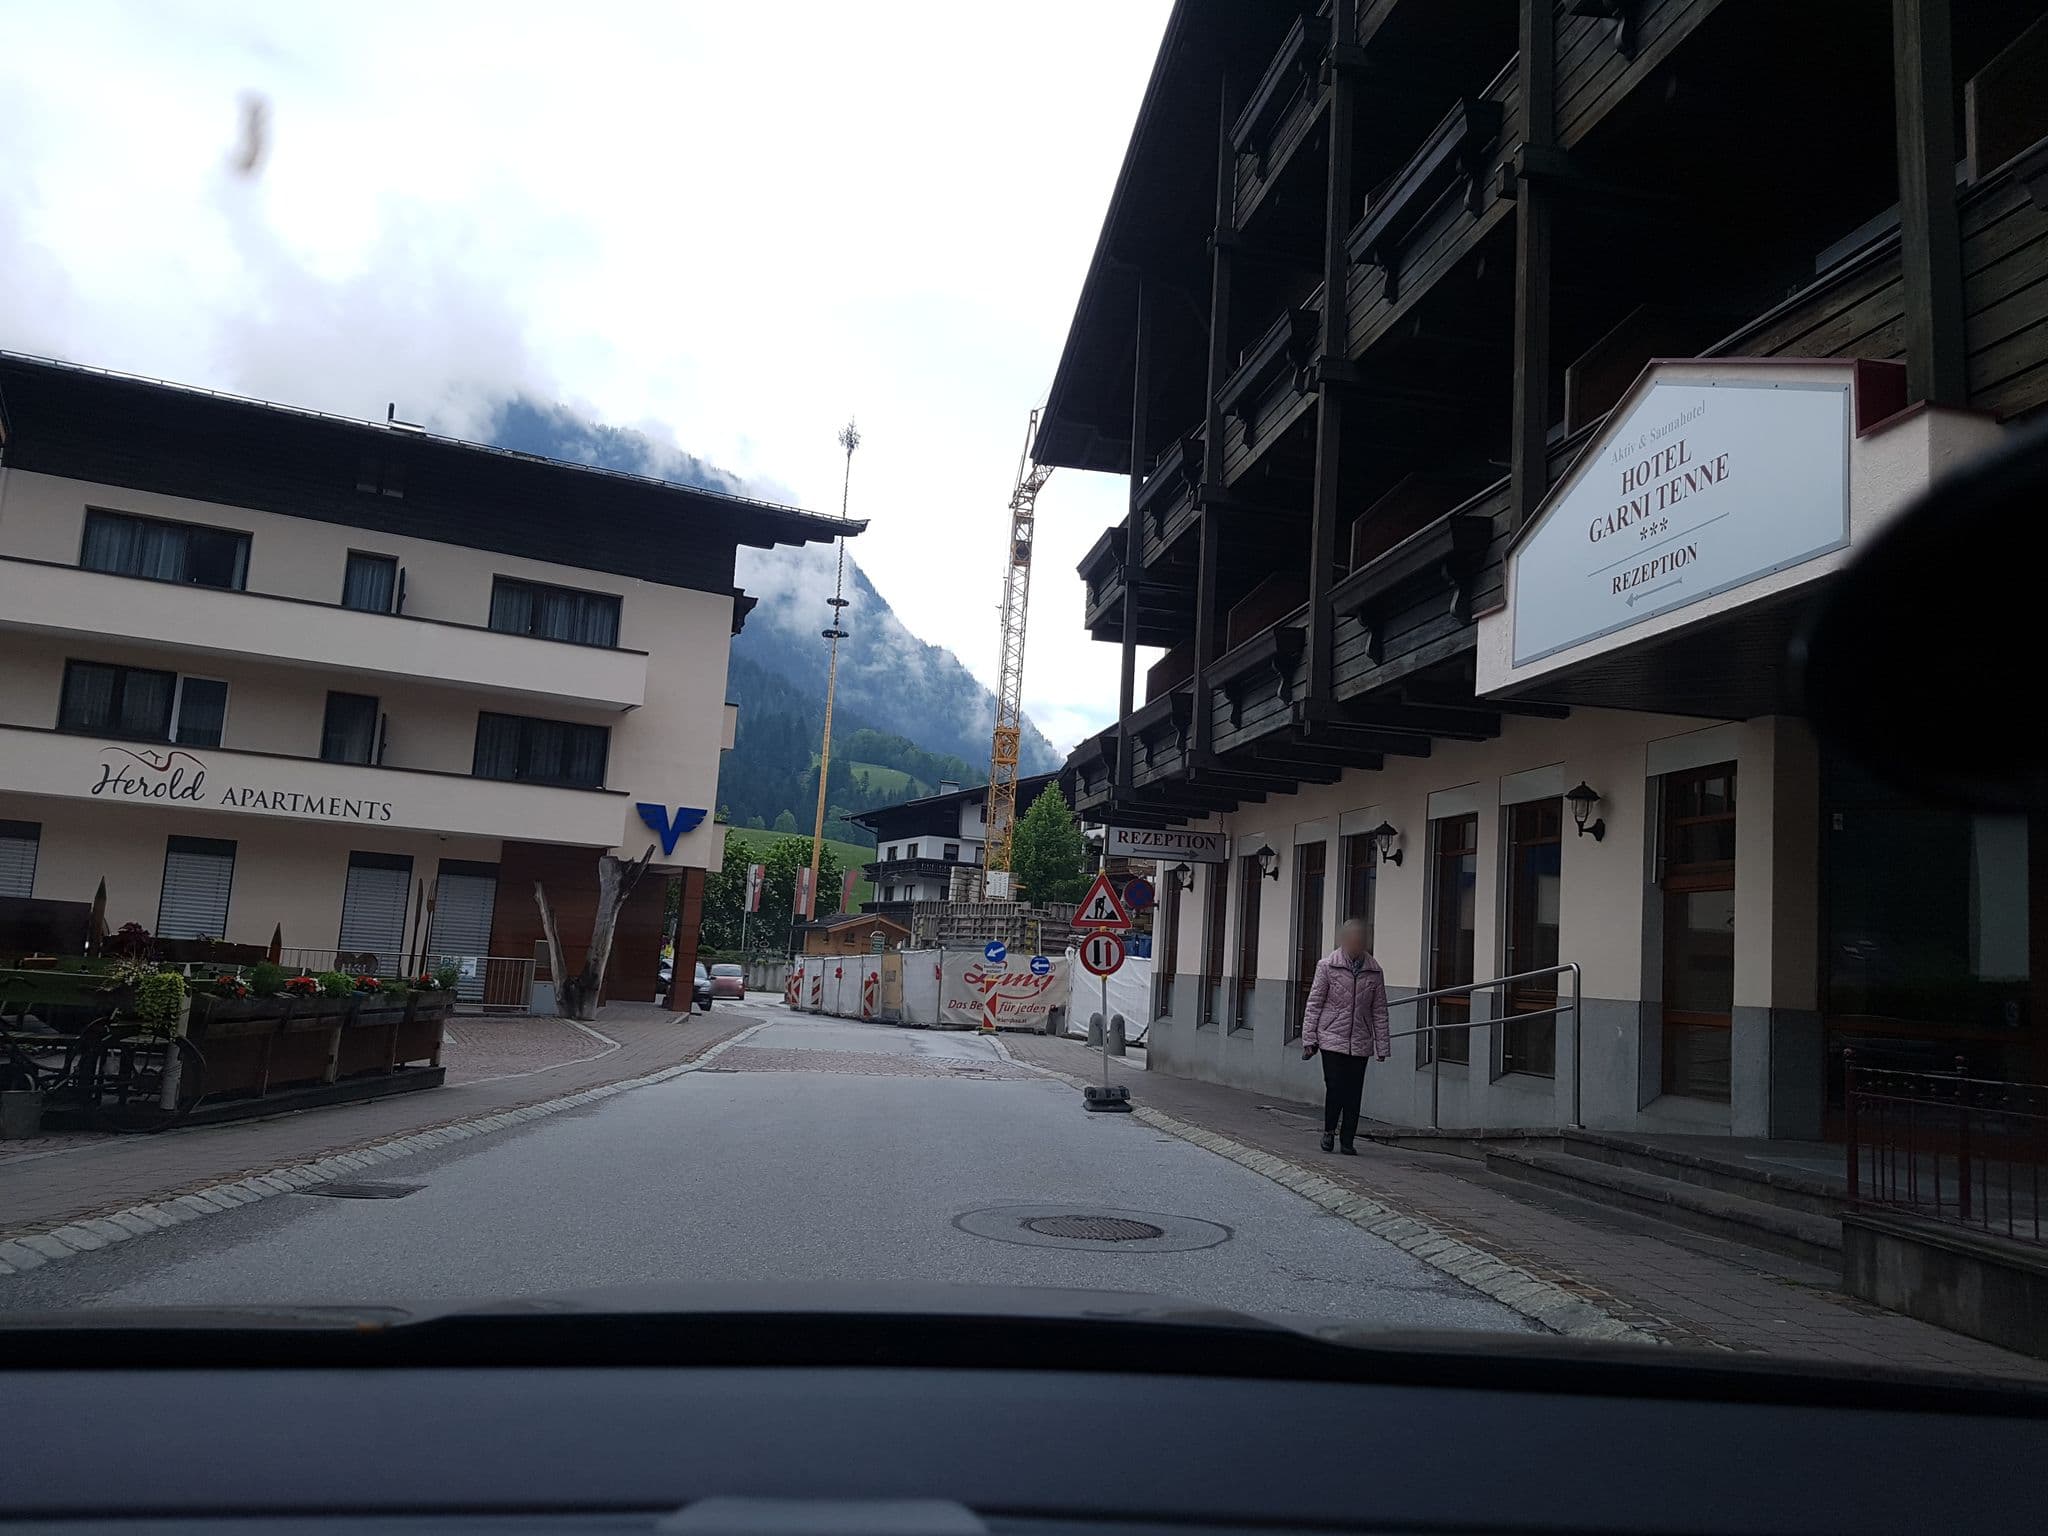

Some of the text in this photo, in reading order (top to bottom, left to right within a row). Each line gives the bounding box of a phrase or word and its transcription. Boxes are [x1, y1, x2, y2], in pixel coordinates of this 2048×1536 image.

[1611, 400, 1706, 464] Aktiv & Saunahotel
[1620, 439, 1692, 496] HOTEL
[1589, 453, 1729, 543] GARNI TENNE
[1612, 543, 1698, 595] REZEPTION
[91, 763, 392, 821] Herold APARTMENTS
[1117, 830, 1217, 850] REZEPTION
[948, 999, 967, 1010] Das
[998, 1001, 1016, 1014] für
[1014, 1002, 1047, 1016] jeden
